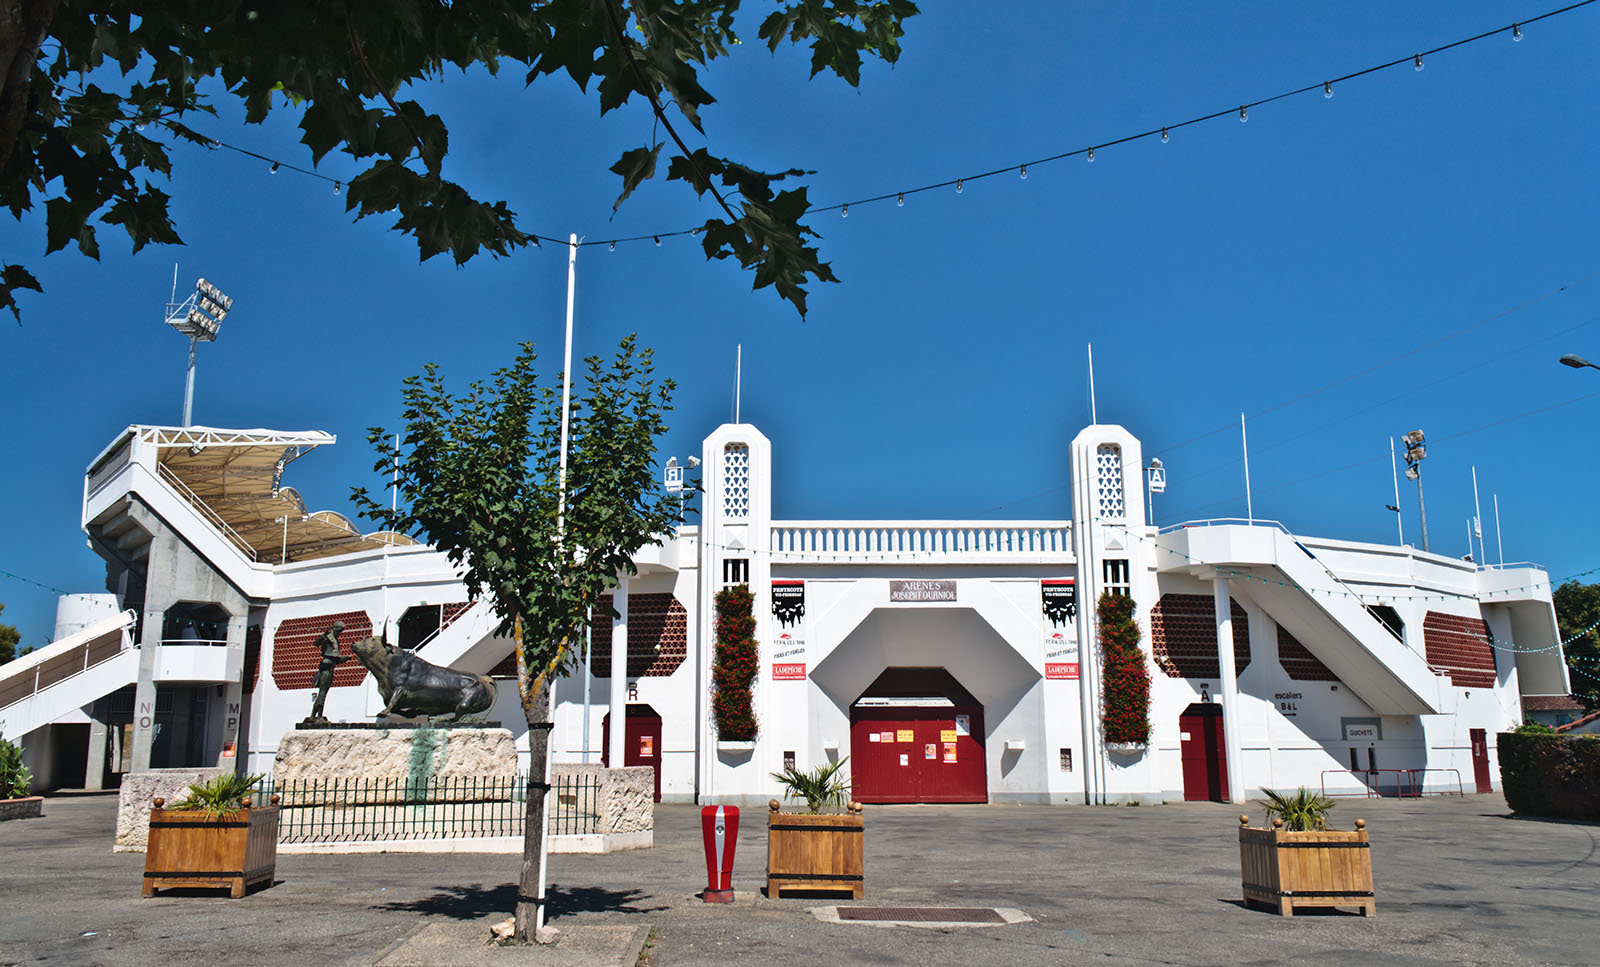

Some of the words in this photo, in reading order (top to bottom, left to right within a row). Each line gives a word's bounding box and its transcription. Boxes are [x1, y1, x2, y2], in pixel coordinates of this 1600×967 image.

[1152, 469, 1162, 481] A
[628, 688, 638, 701] R
[1200, 690, 1210, 702] A
[1275, 691, 1302, 699] escaliers
[1281, 702, 1286, 711] B
[228, 717, 237, 728] P
